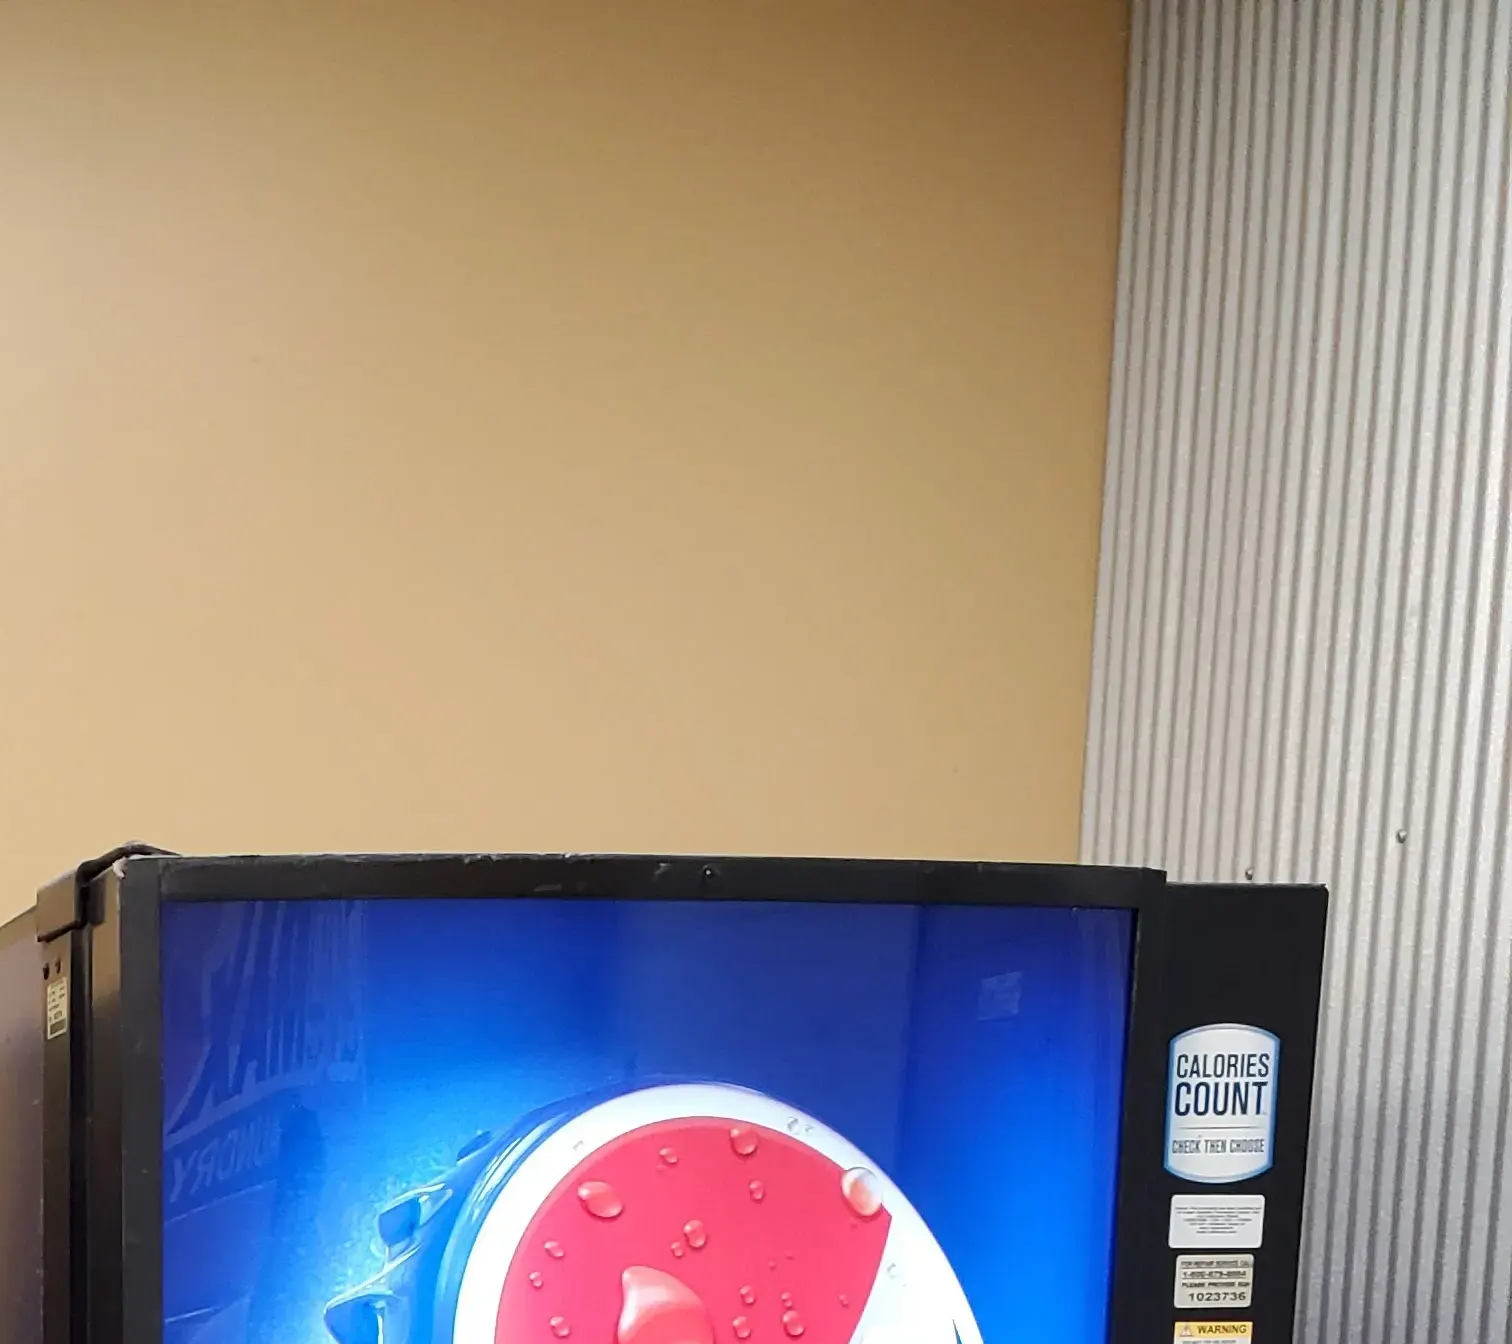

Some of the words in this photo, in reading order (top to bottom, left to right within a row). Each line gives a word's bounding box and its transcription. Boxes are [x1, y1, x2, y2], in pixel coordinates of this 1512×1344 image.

[1176, 1053, 1270, 1079] CALORIES
[1174, 1081, 1268, 1117] COUNT
[1171, 1139, 1201, 1154] CHECK
[1204, 1139, 1227, 1154] THEN
[1229, 1138, 1265, 1153] CHOOSE
[1188, 1291, 1247, 1302] 1023736
[1197, 1324, 1247, 1334] WARNING
